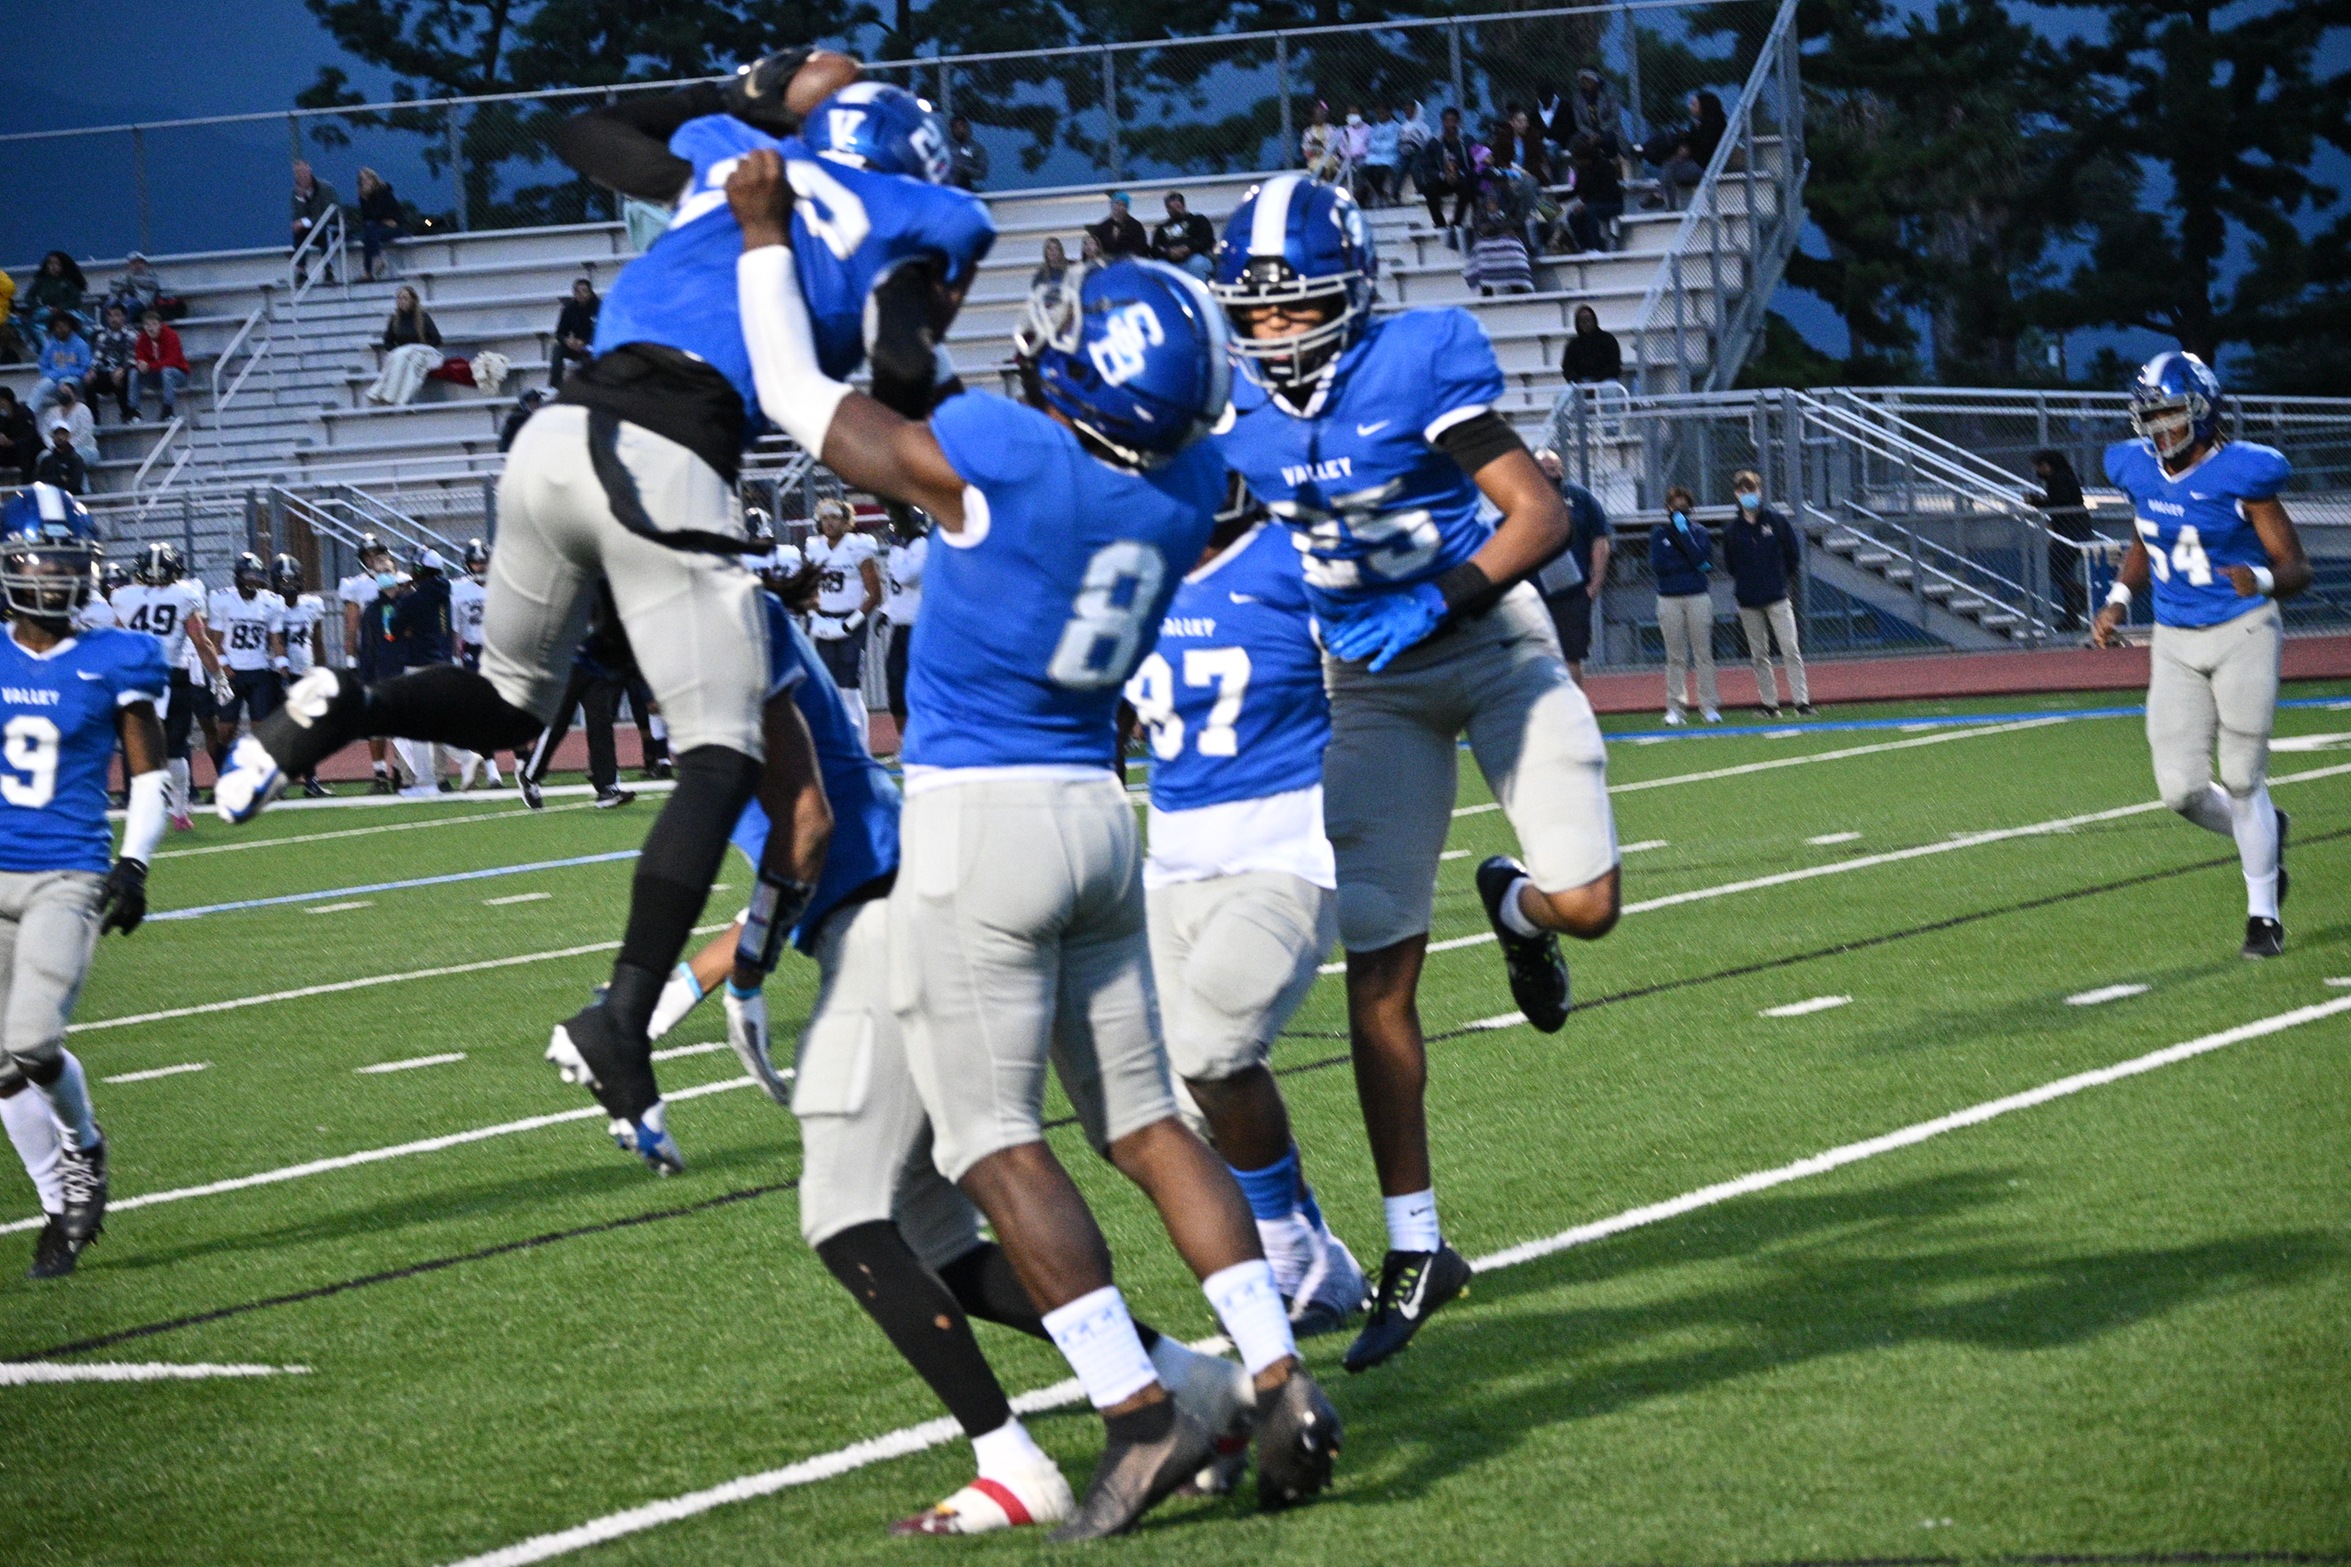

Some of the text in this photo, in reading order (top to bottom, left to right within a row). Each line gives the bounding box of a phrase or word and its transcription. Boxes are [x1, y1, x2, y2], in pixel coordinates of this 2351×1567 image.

[1281, 456, 1353, 488] VALLEY
[2133, 515, 2214, 587] 54
[129, 603, 178, 636] 49
[1047, 539, 1166, 690] 8
[1158, 616, 1217, 638] ALLEY
[1124, 645, 1252, 762] 97
[0, 714, 61, 809] 9
